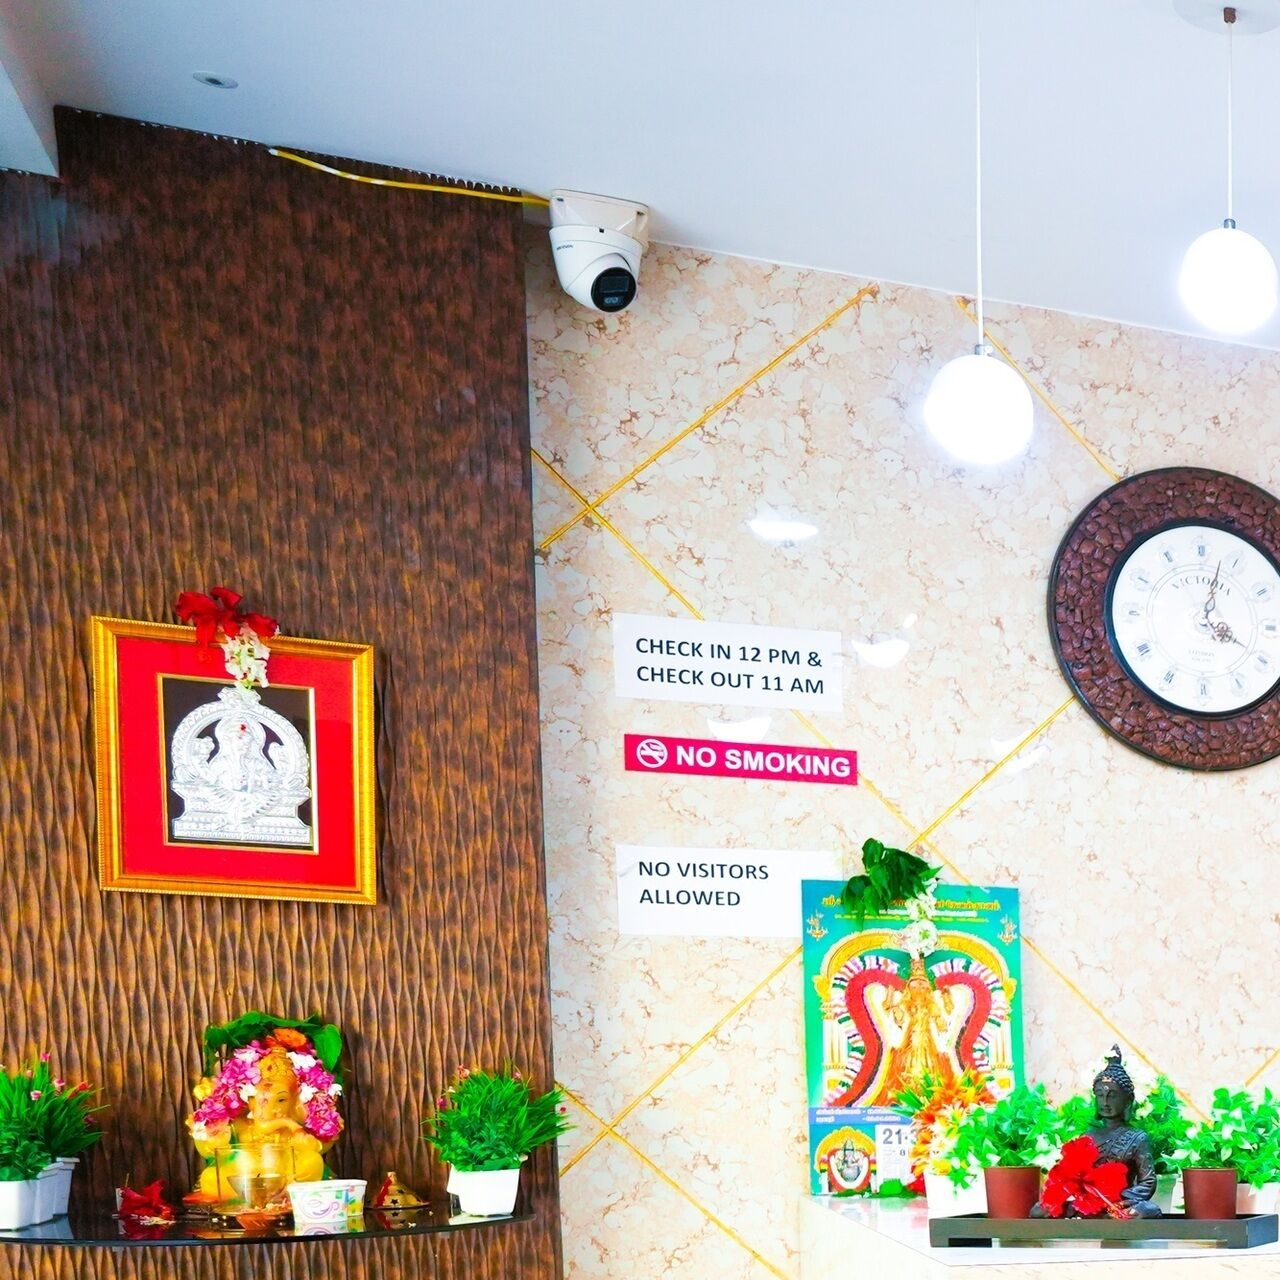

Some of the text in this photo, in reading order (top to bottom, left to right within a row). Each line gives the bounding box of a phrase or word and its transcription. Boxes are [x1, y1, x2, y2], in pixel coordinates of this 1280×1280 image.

[635, 637, 822, 667] CHECK IN 12 PM &
[637, 666, 824, 694] CHECK OUT 11 AM
[676, 745, 850, 778] NO SMOKING
[639, 861, 769, 880] NO VISITORS
[639, 889, 741, 906] ALLOWED
